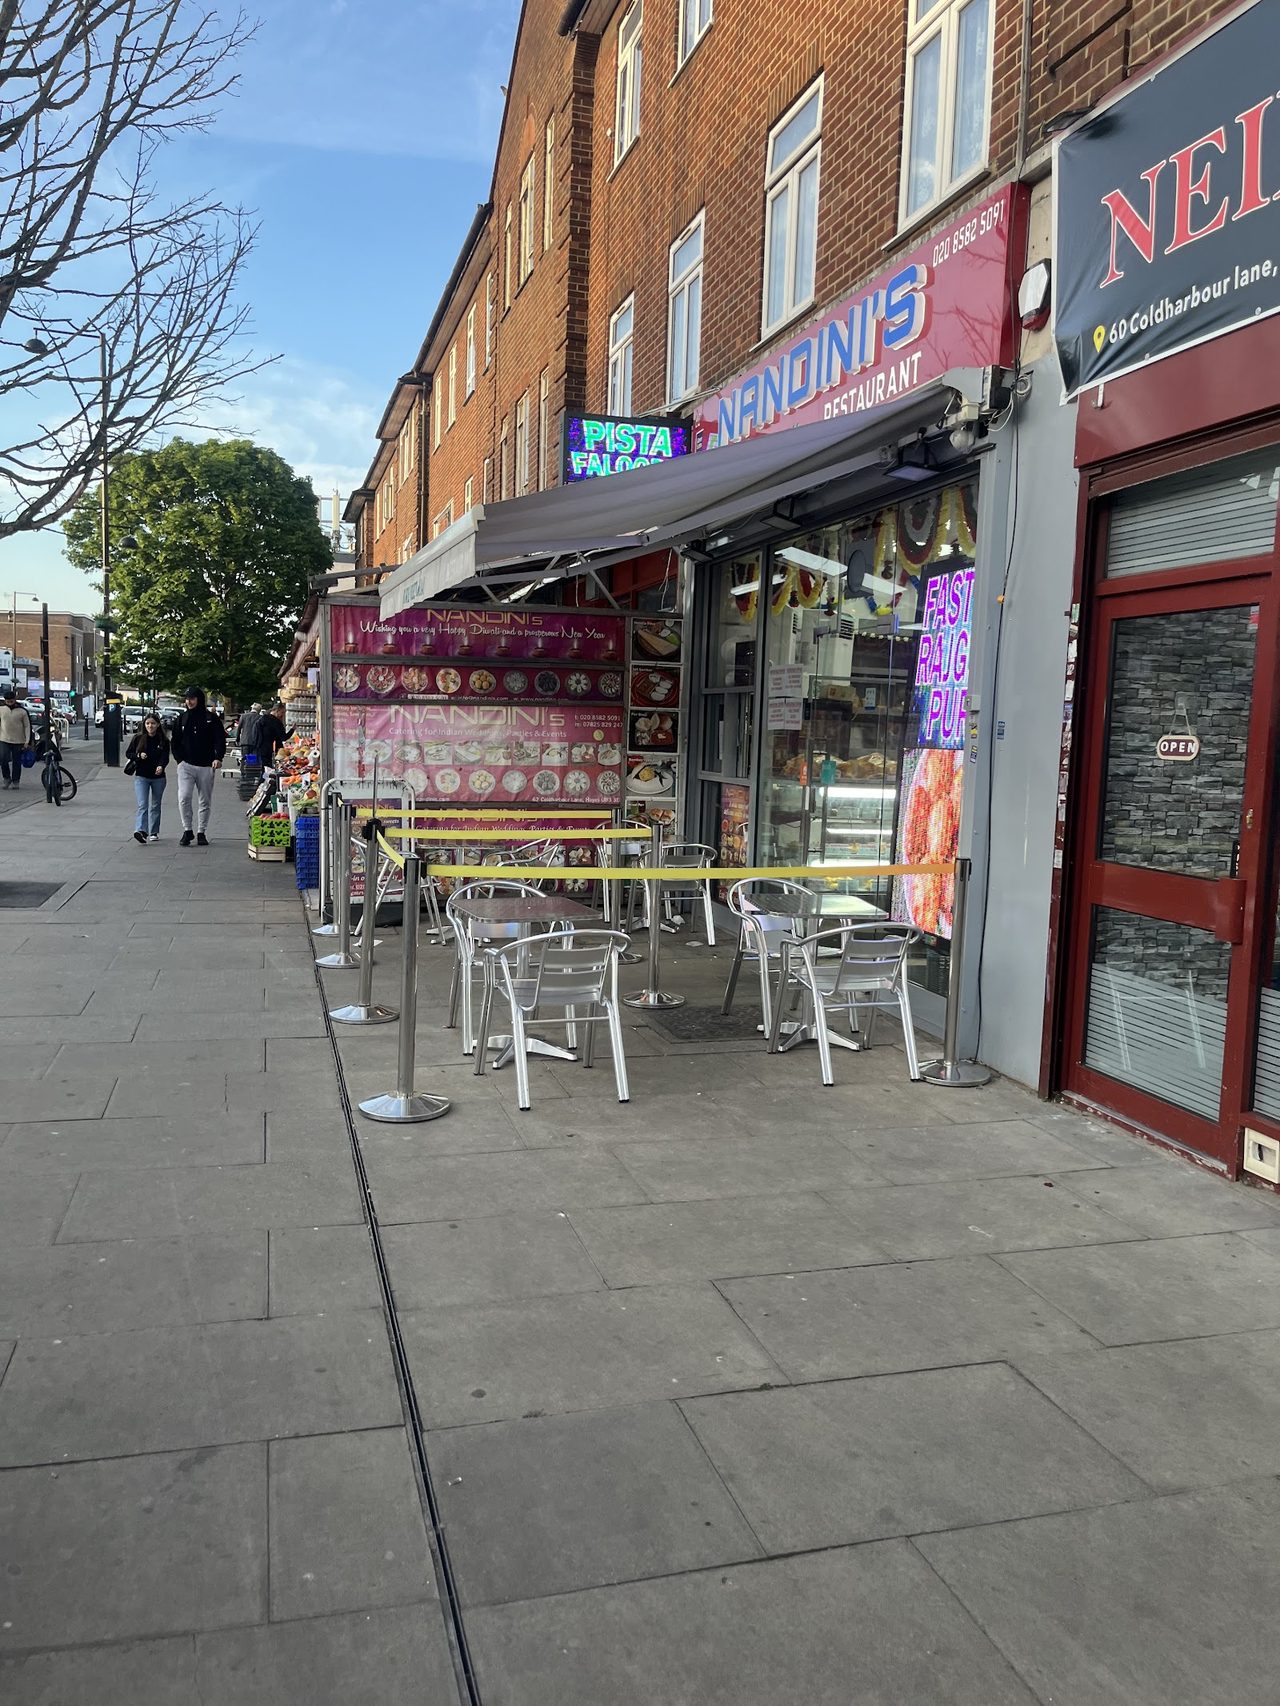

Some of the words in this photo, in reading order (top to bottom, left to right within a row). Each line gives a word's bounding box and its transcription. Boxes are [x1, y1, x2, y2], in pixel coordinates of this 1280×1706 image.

[1100, 89, 1280, 288] NEI
[932, 237, 950, 268] 020
[952, 221, 977, 254] 8582
[979, 199, 1006, 236] 5091
[1109, 318, 1128, 344] 60
[1130, 273, 1231, 335] Coldharbour
[1234, 258, 1278, 291] lane,
[718, 263, 928, 446] NANDINI'S
[823, 351, 923, 420] RESTAURANT
[571, 450, 664, 477] FALOO
[582, 419, 672, 457] PISTA
[360, 620, 398, 635] Wishing
[398, 625, 412, 635] you
[438, 623, 467, 636] Happy
[469, 623, 500, 636] Diwali
[500, 627, 516, 636] and
[585, 627, 606, 639] Year
[922, 567, 976, 631] FAST
[389, 727, 423, 737] Catering
[437, 729, 463, 737] Indian
[1160, 740, 1197, 754] OPEN
